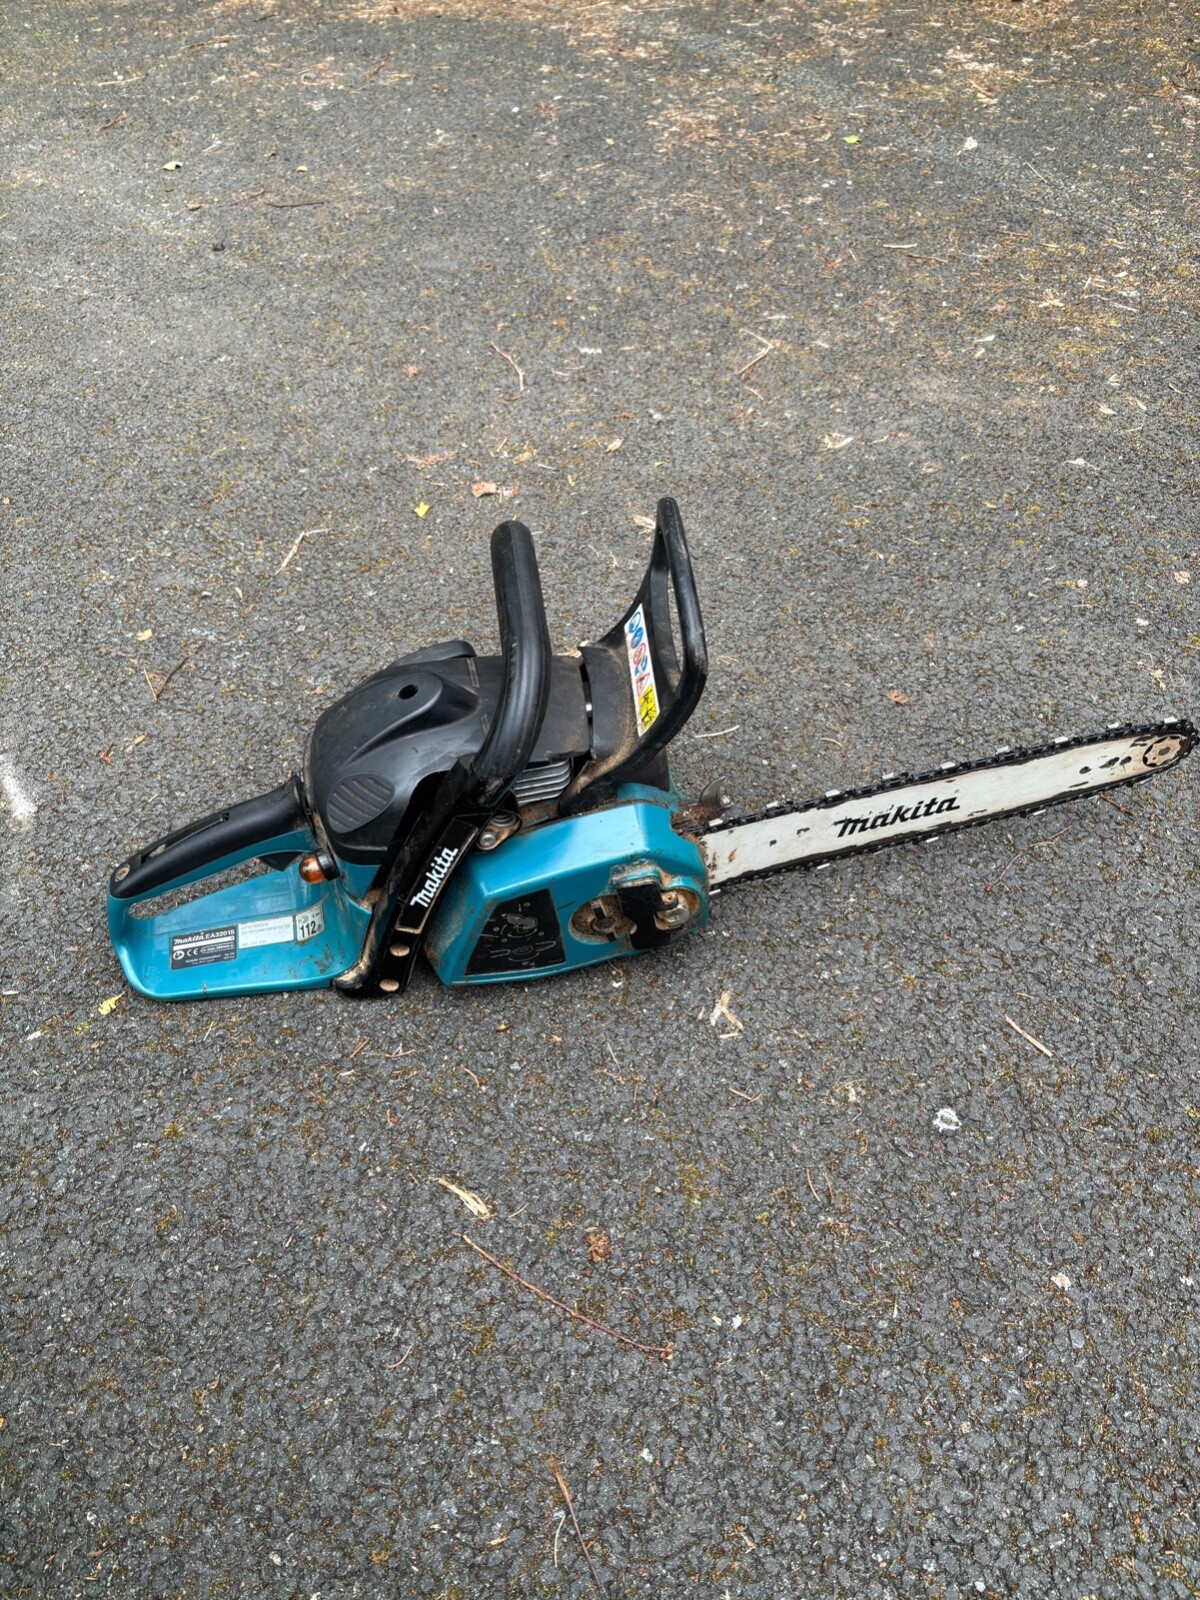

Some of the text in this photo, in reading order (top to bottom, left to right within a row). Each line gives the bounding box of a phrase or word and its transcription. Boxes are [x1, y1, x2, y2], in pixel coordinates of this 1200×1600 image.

[833, 797, 960, 838] makita
[409, 847, 459, 908] makita
[174, 932, 205, 945] makita
[300, 920, 317, 938] 112
